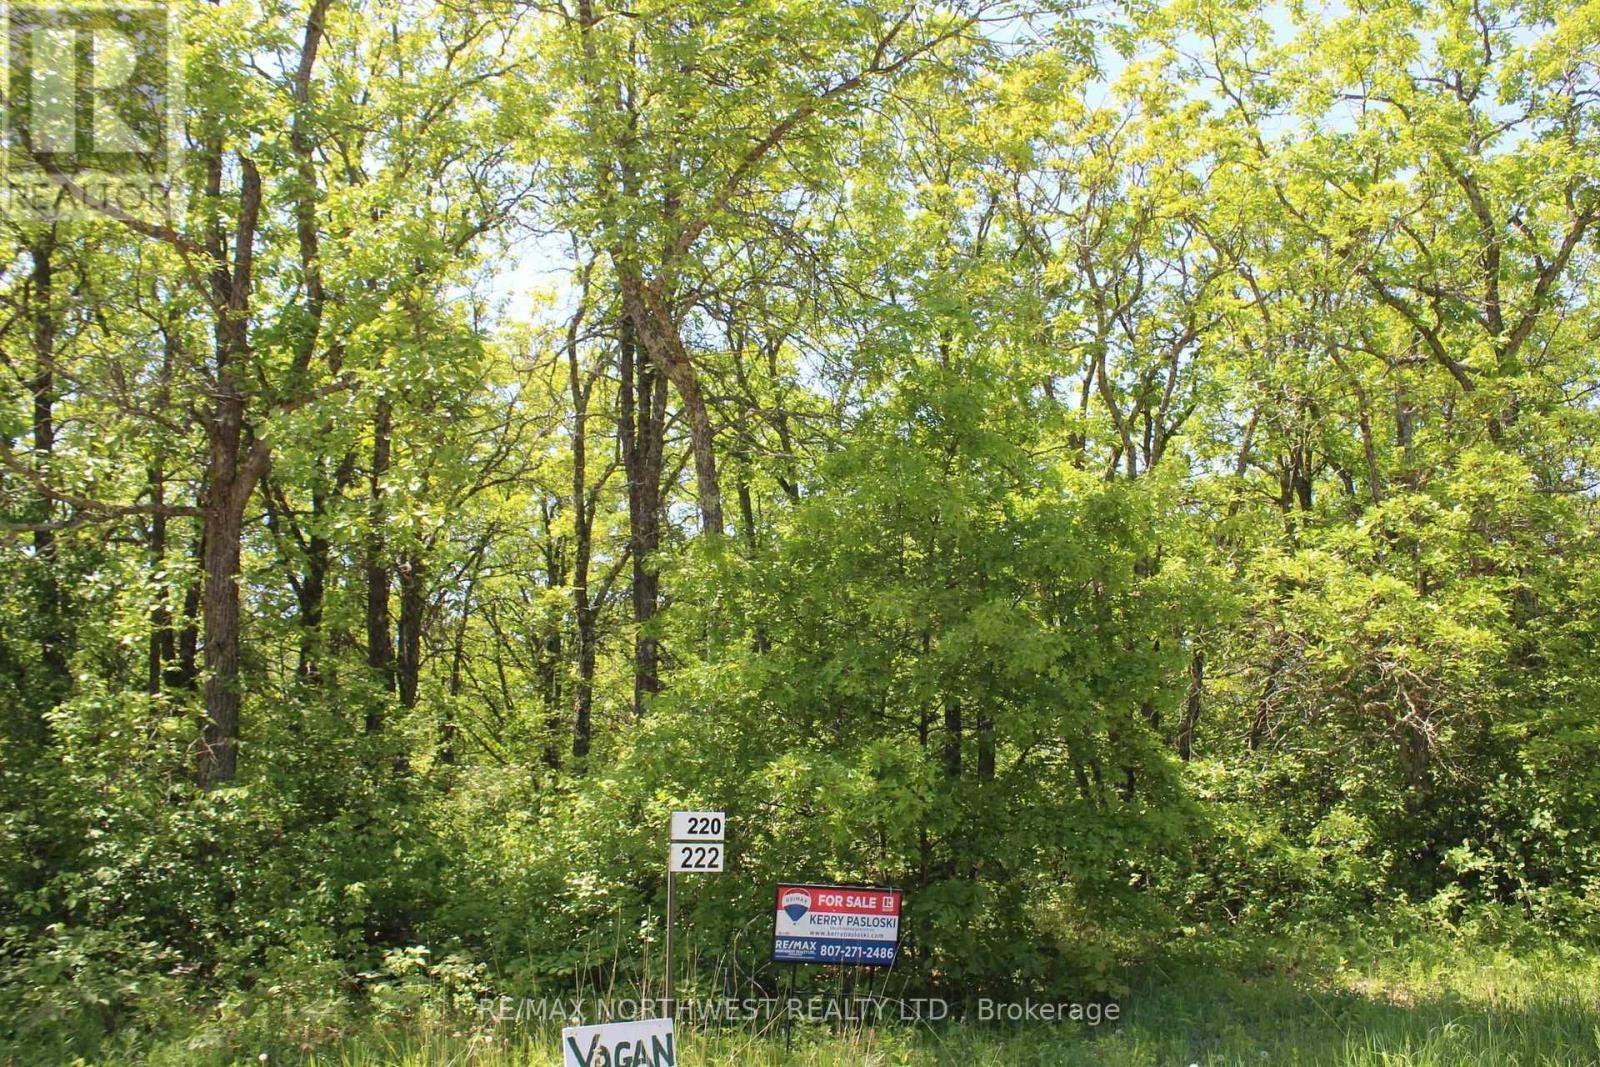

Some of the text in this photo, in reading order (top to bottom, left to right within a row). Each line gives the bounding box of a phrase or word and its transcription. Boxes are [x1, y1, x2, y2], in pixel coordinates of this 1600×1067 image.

[687, 817, 721, 835] 220
[681, 847, 719, 868] 222
[818, 895, 877, 908] FOR SALE
[809, 914, 896, 928] KERRY PASLOSKI
[775, 939, 817, 951] RE/MAX
[820, 945, 894, 959] 807-271-2486
